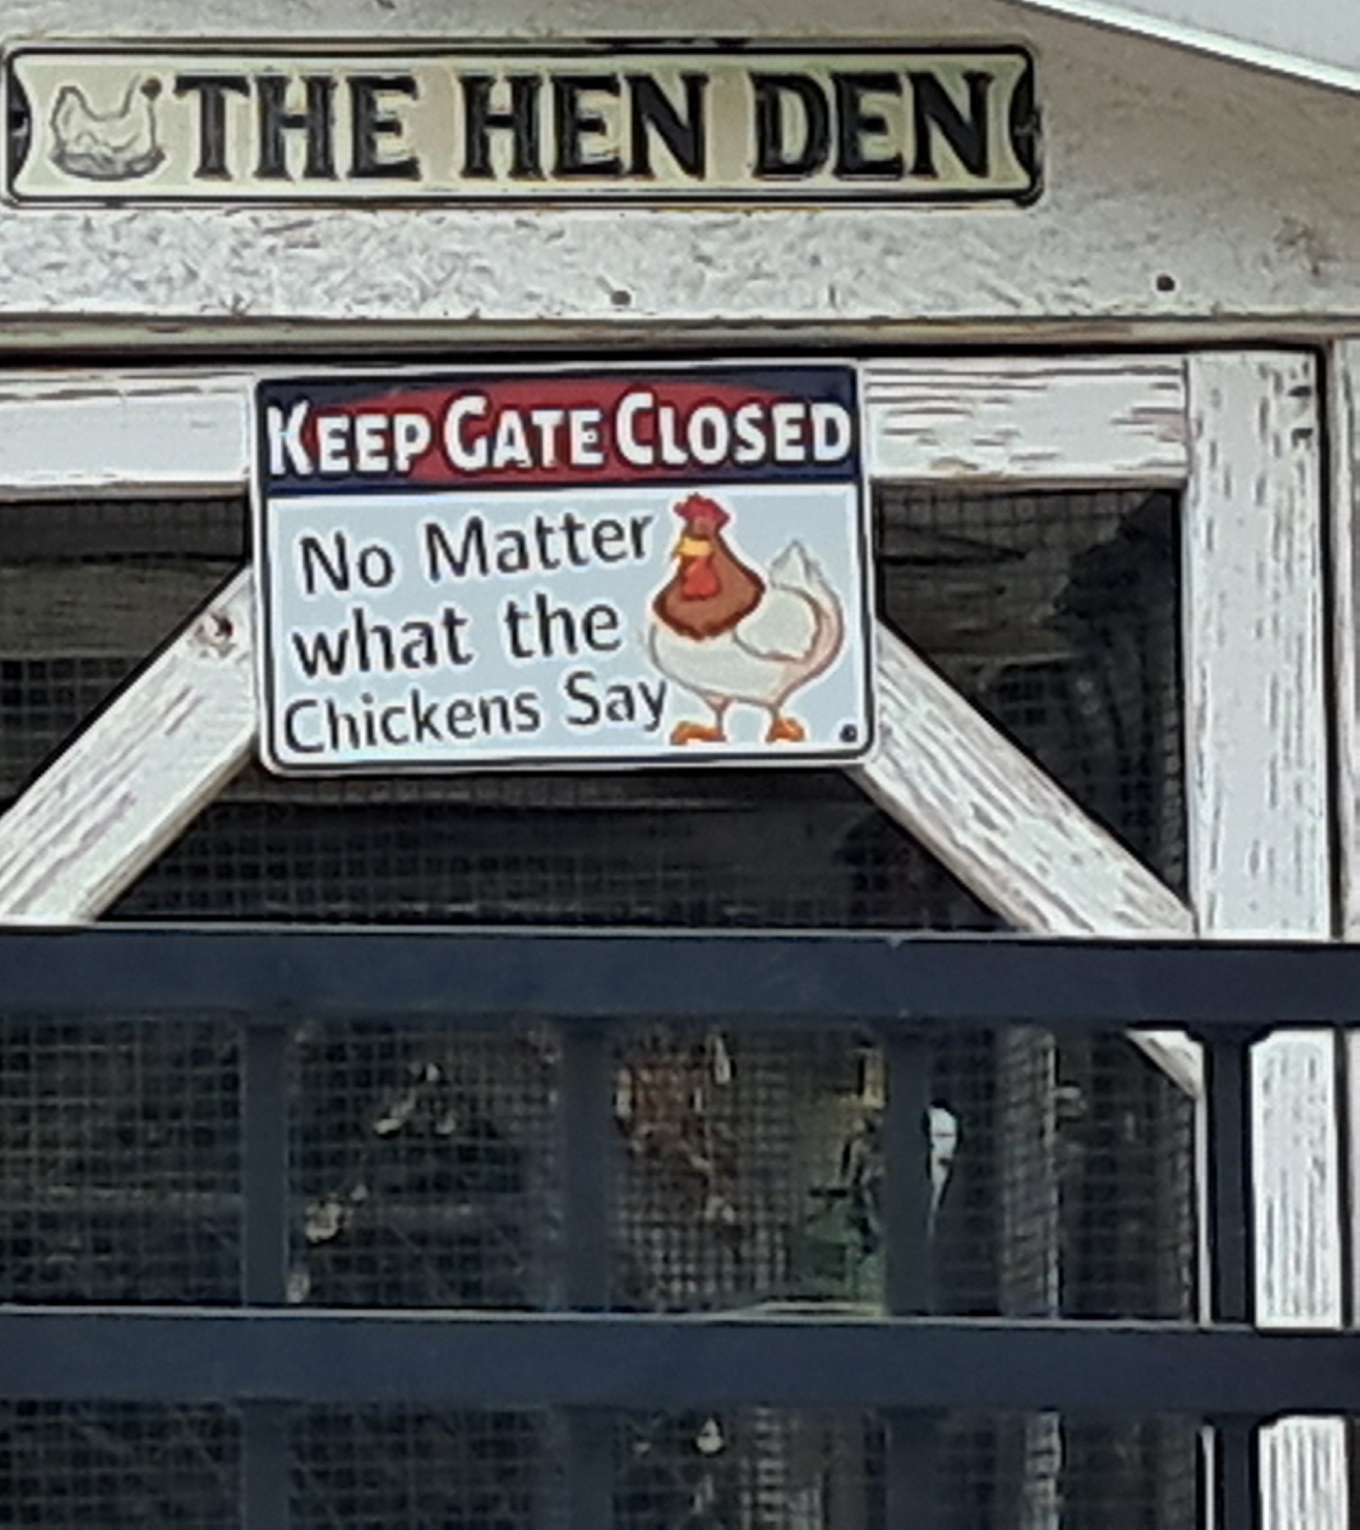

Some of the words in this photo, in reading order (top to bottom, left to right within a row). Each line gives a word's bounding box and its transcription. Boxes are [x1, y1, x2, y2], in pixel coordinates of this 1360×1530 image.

[174, 75, 421, 180] THE
[457, 73, 711, 180] HEN
[743, 73, 997, 179] DEN
[299, 532, 394, 594] No
[423, 512, 653, 582] Matter
[293, 606, 473, 677] what
[504, 594, 622, 658] the
[284, 688, 541, 754] Chickens
[564, 671, 668, 731] Say
